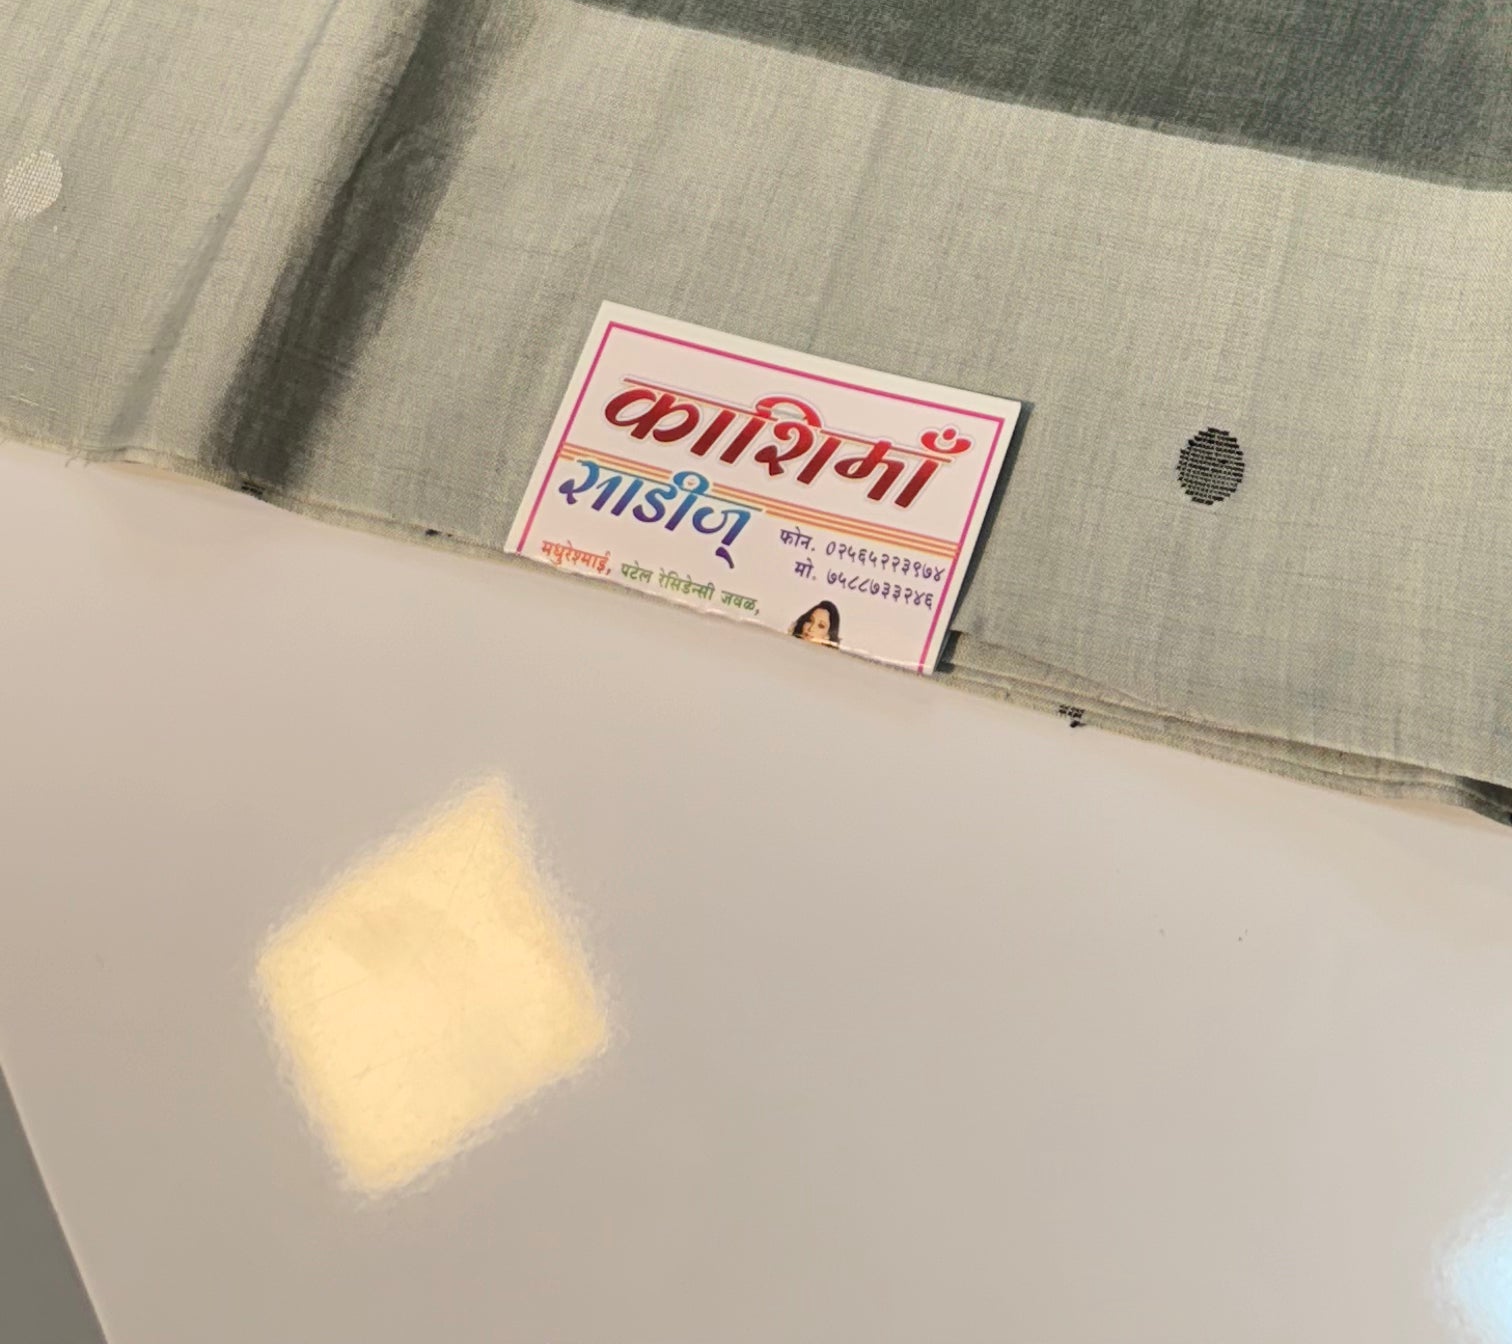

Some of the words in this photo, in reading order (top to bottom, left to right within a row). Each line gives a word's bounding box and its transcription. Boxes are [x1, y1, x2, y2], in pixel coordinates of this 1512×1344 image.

[780, 526, 815, 552] फोन.
[620, 559, 653, 584] पटेल
[794, 557, 816, 581] मो.
[826, 568, 934, 610] ७५८८७३३२४६
